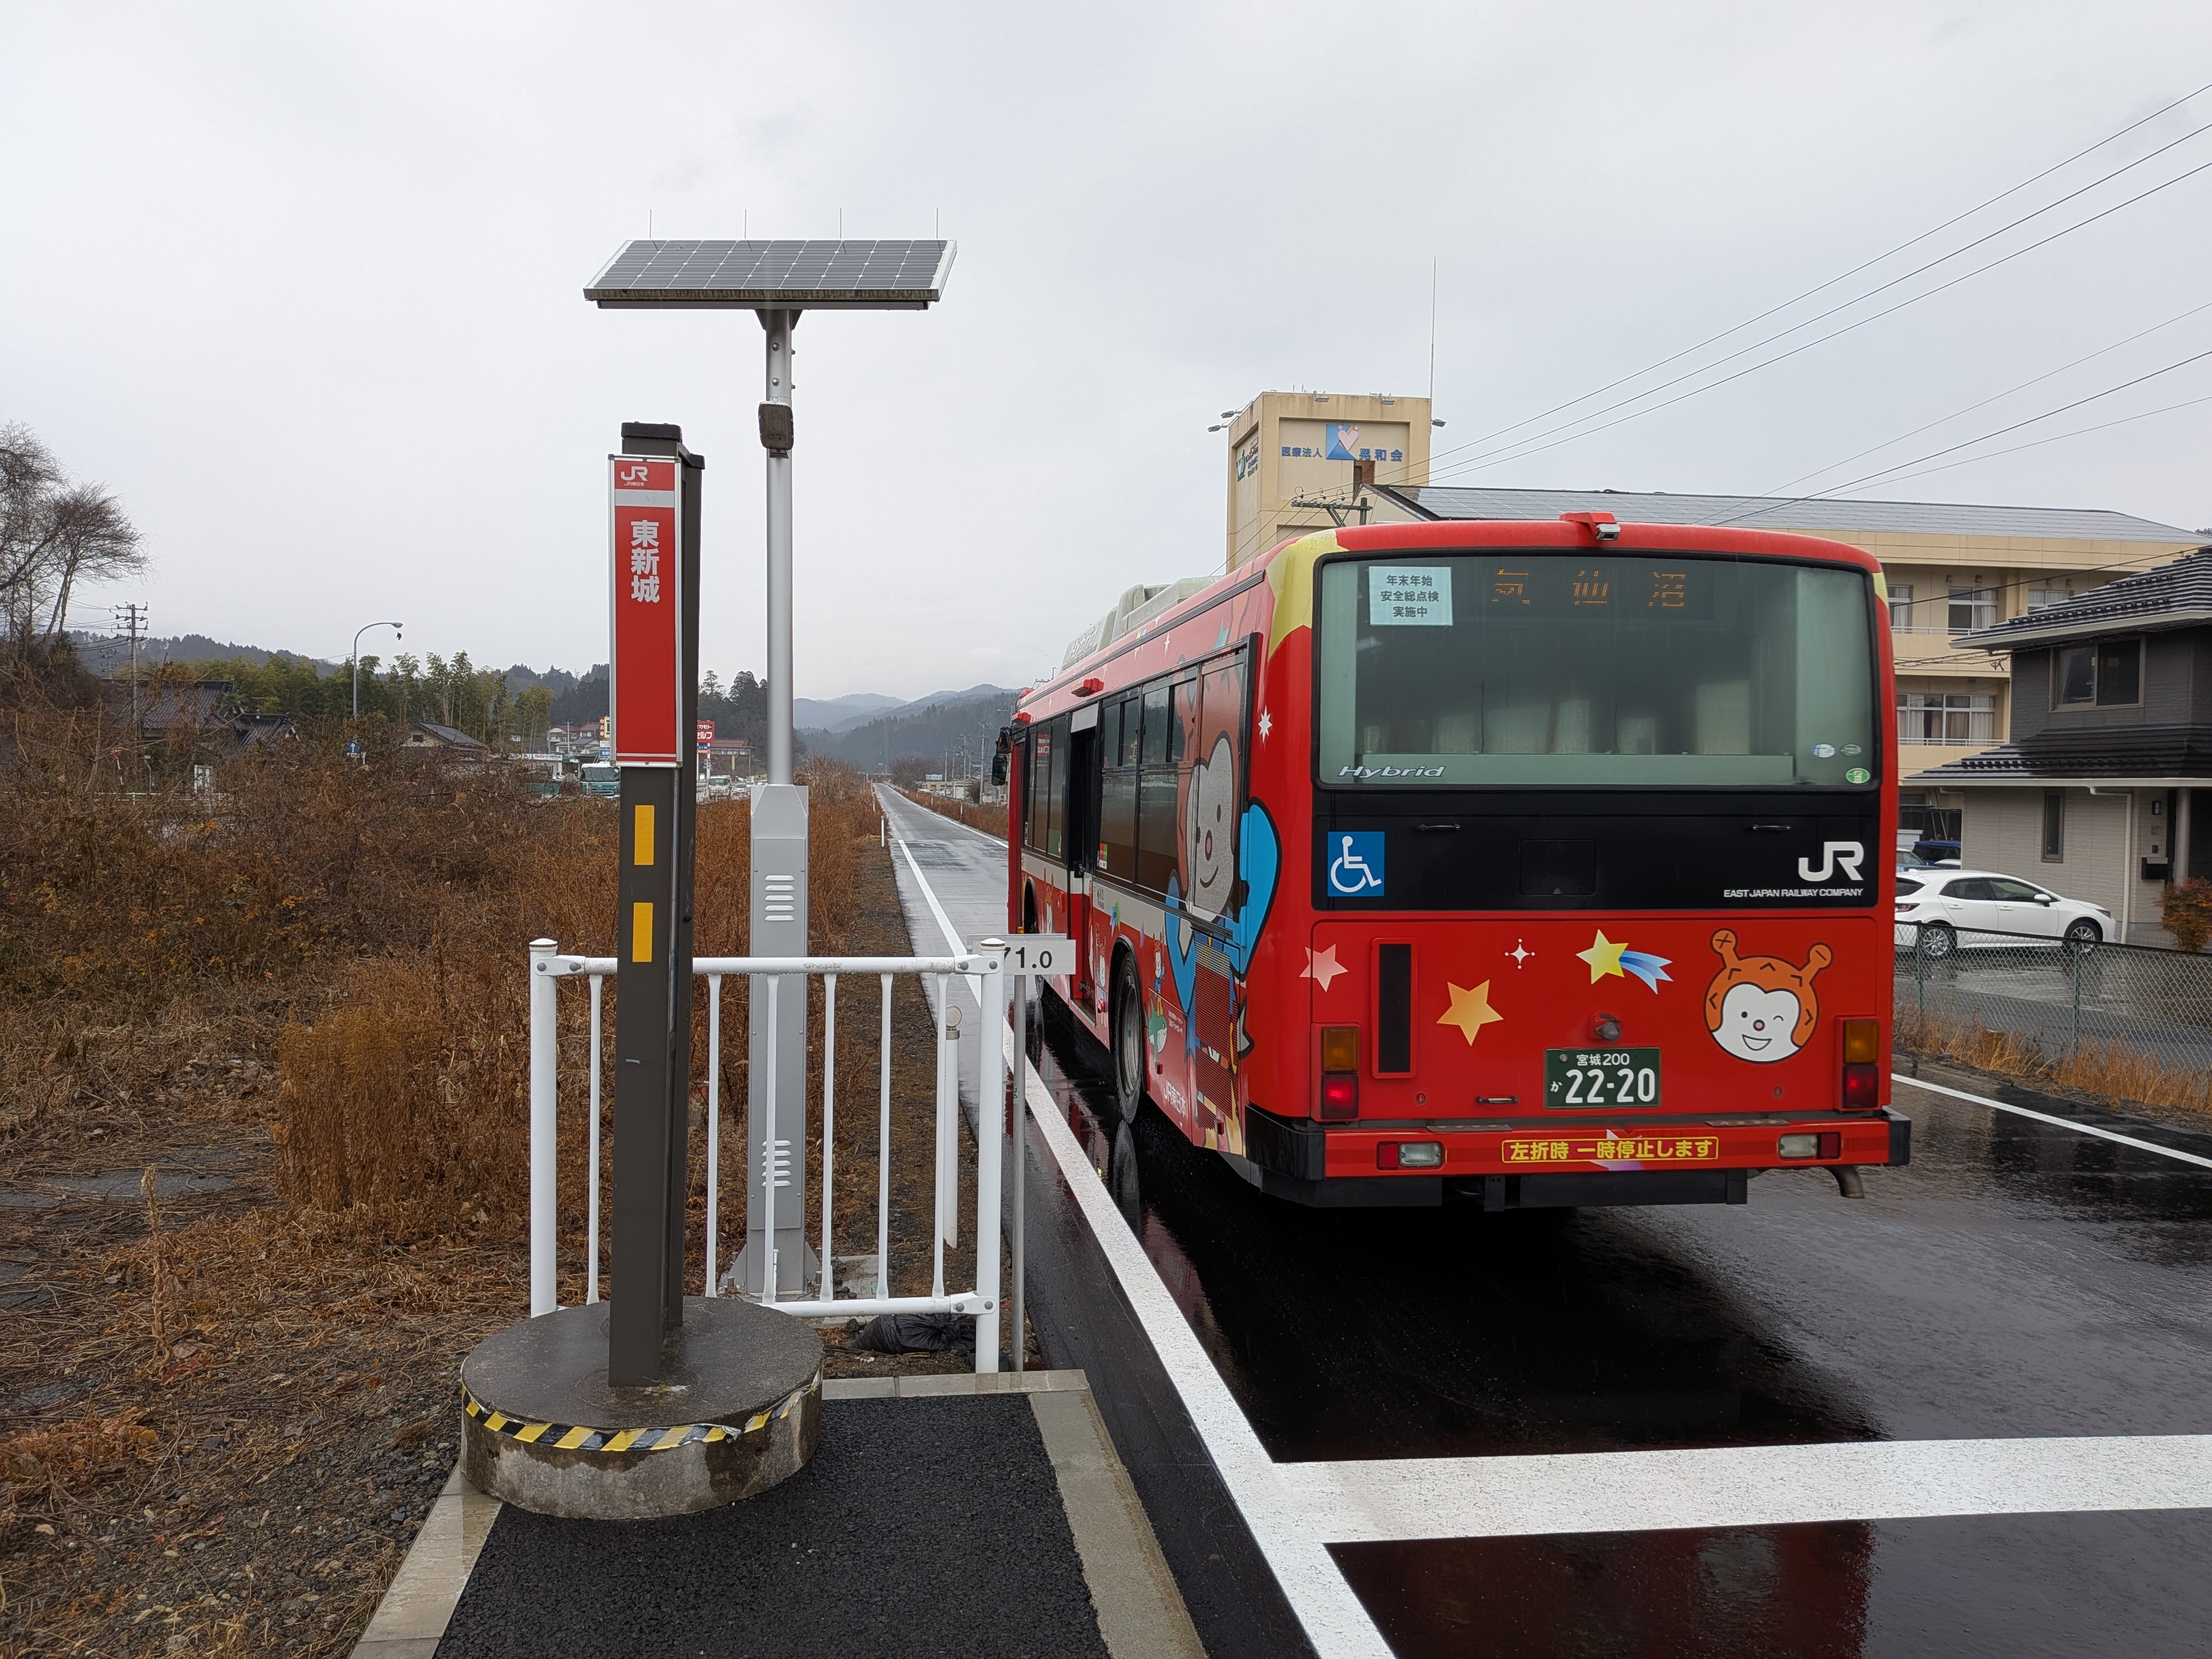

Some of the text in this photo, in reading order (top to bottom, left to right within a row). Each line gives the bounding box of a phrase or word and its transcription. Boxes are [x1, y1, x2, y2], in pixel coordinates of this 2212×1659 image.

[1281, 446, 1403, 462] 医療法人 晃和会
[620, 466, 648, 482] JR
[630, 519, 660, 603] 東新城
[1386, 575, 1433, 587] 年末年始
[1380, 590, 1439, 602] 安全総点検
[1392, 606, 1428, 618] 実施中
[1337, 765, 1447, 779] Hybrid
[1798, 841, 1864, 881] JR
[1724, 888, 1864, 898] EAST JAPAN RAILWAY COMPANY
[1550, 1068, 1655, 1104] か 22-20
[1164, 1079, 1187, 1118] JR東日本
[1510, 1140, 1713, 1161] 左折時 一時停止します
